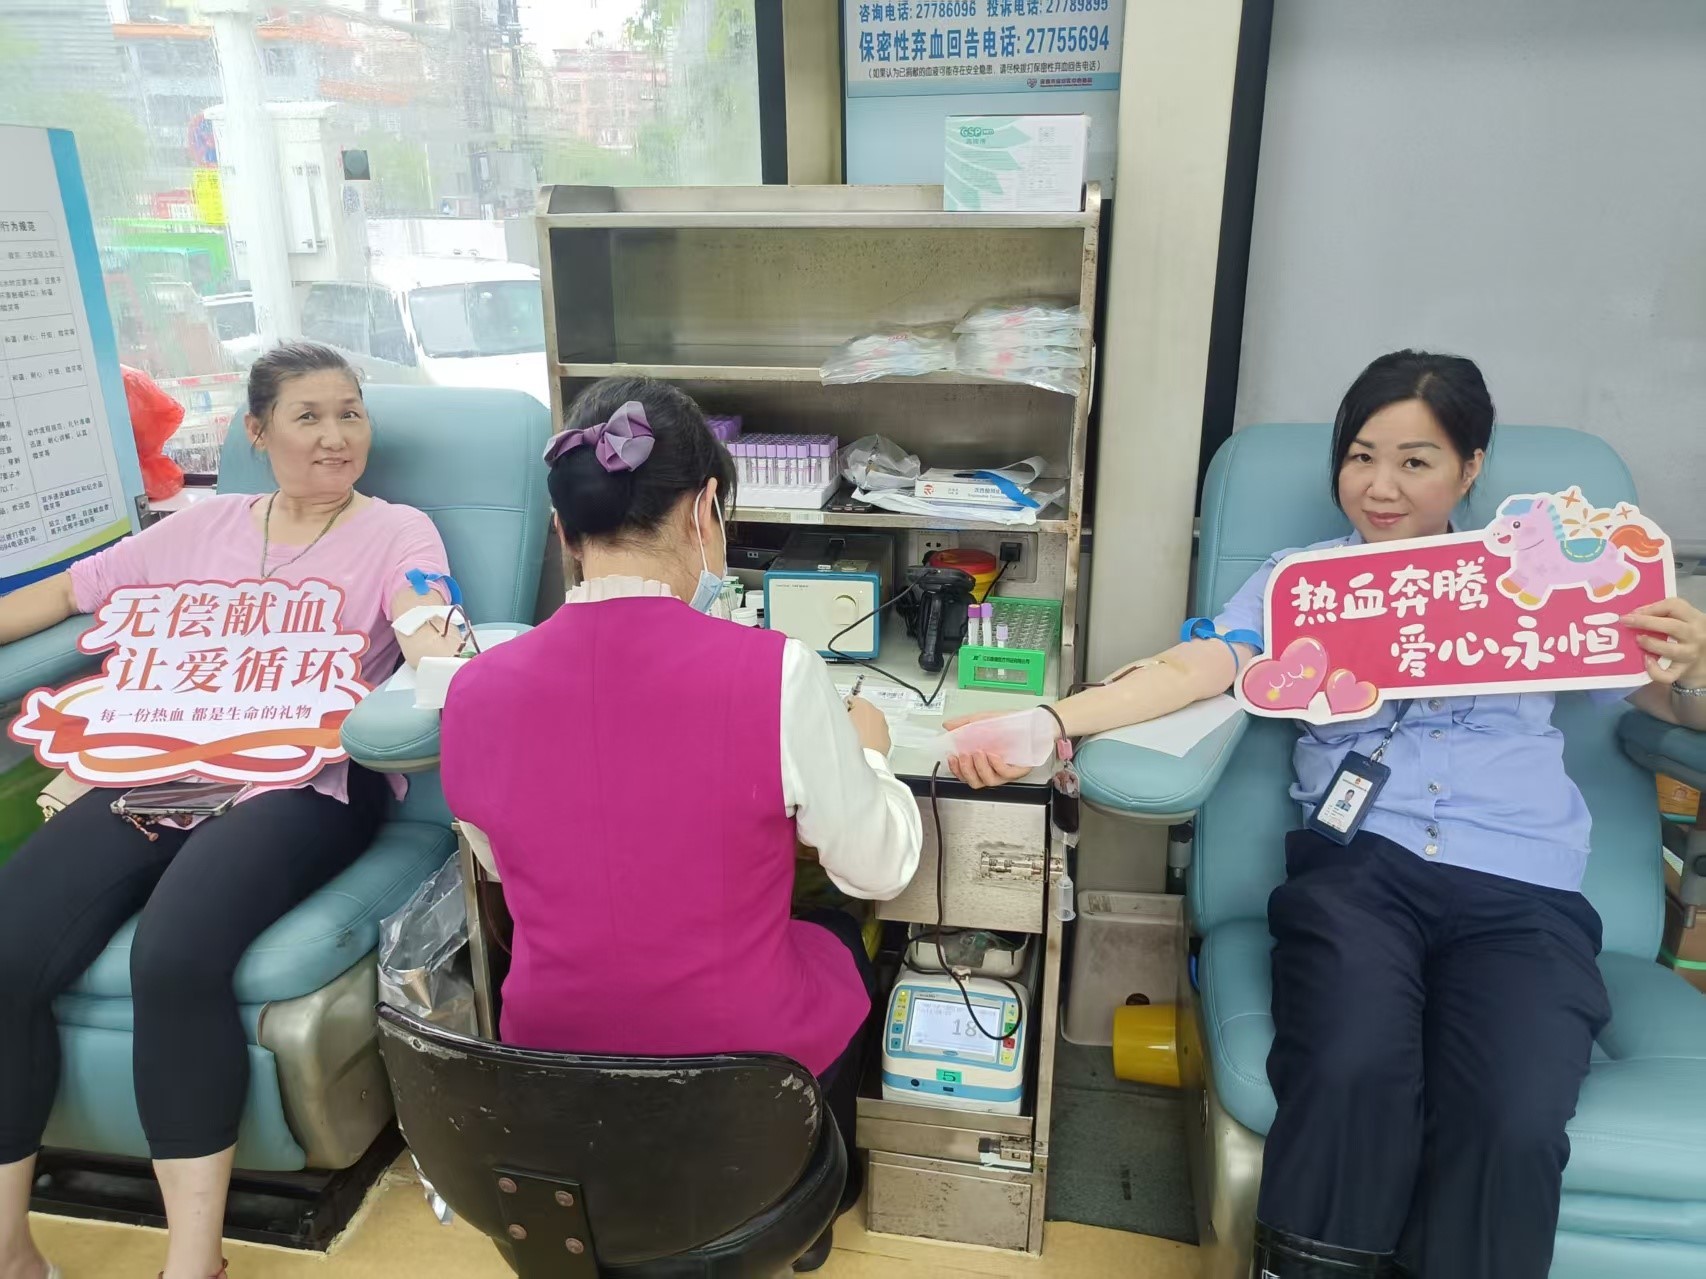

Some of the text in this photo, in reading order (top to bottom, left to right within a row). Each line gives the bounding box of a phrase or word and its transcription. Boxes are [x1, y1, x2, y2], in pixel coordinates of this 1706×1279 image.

[859, 25, 1110, 62] 保密性弃血回告电话:27755694
[104, 591, 328, 640] 无偿献血
[1290, 556, 1489, 627] 热血奔腾
[1390, 612, 1626, 678] 爱心永恒
[116, 646, 350, 694] 让爱循环
[100, 704, 313, 723] 每一份热血 都是生命的礼物
[942, 1071, 957, 1083] 5
